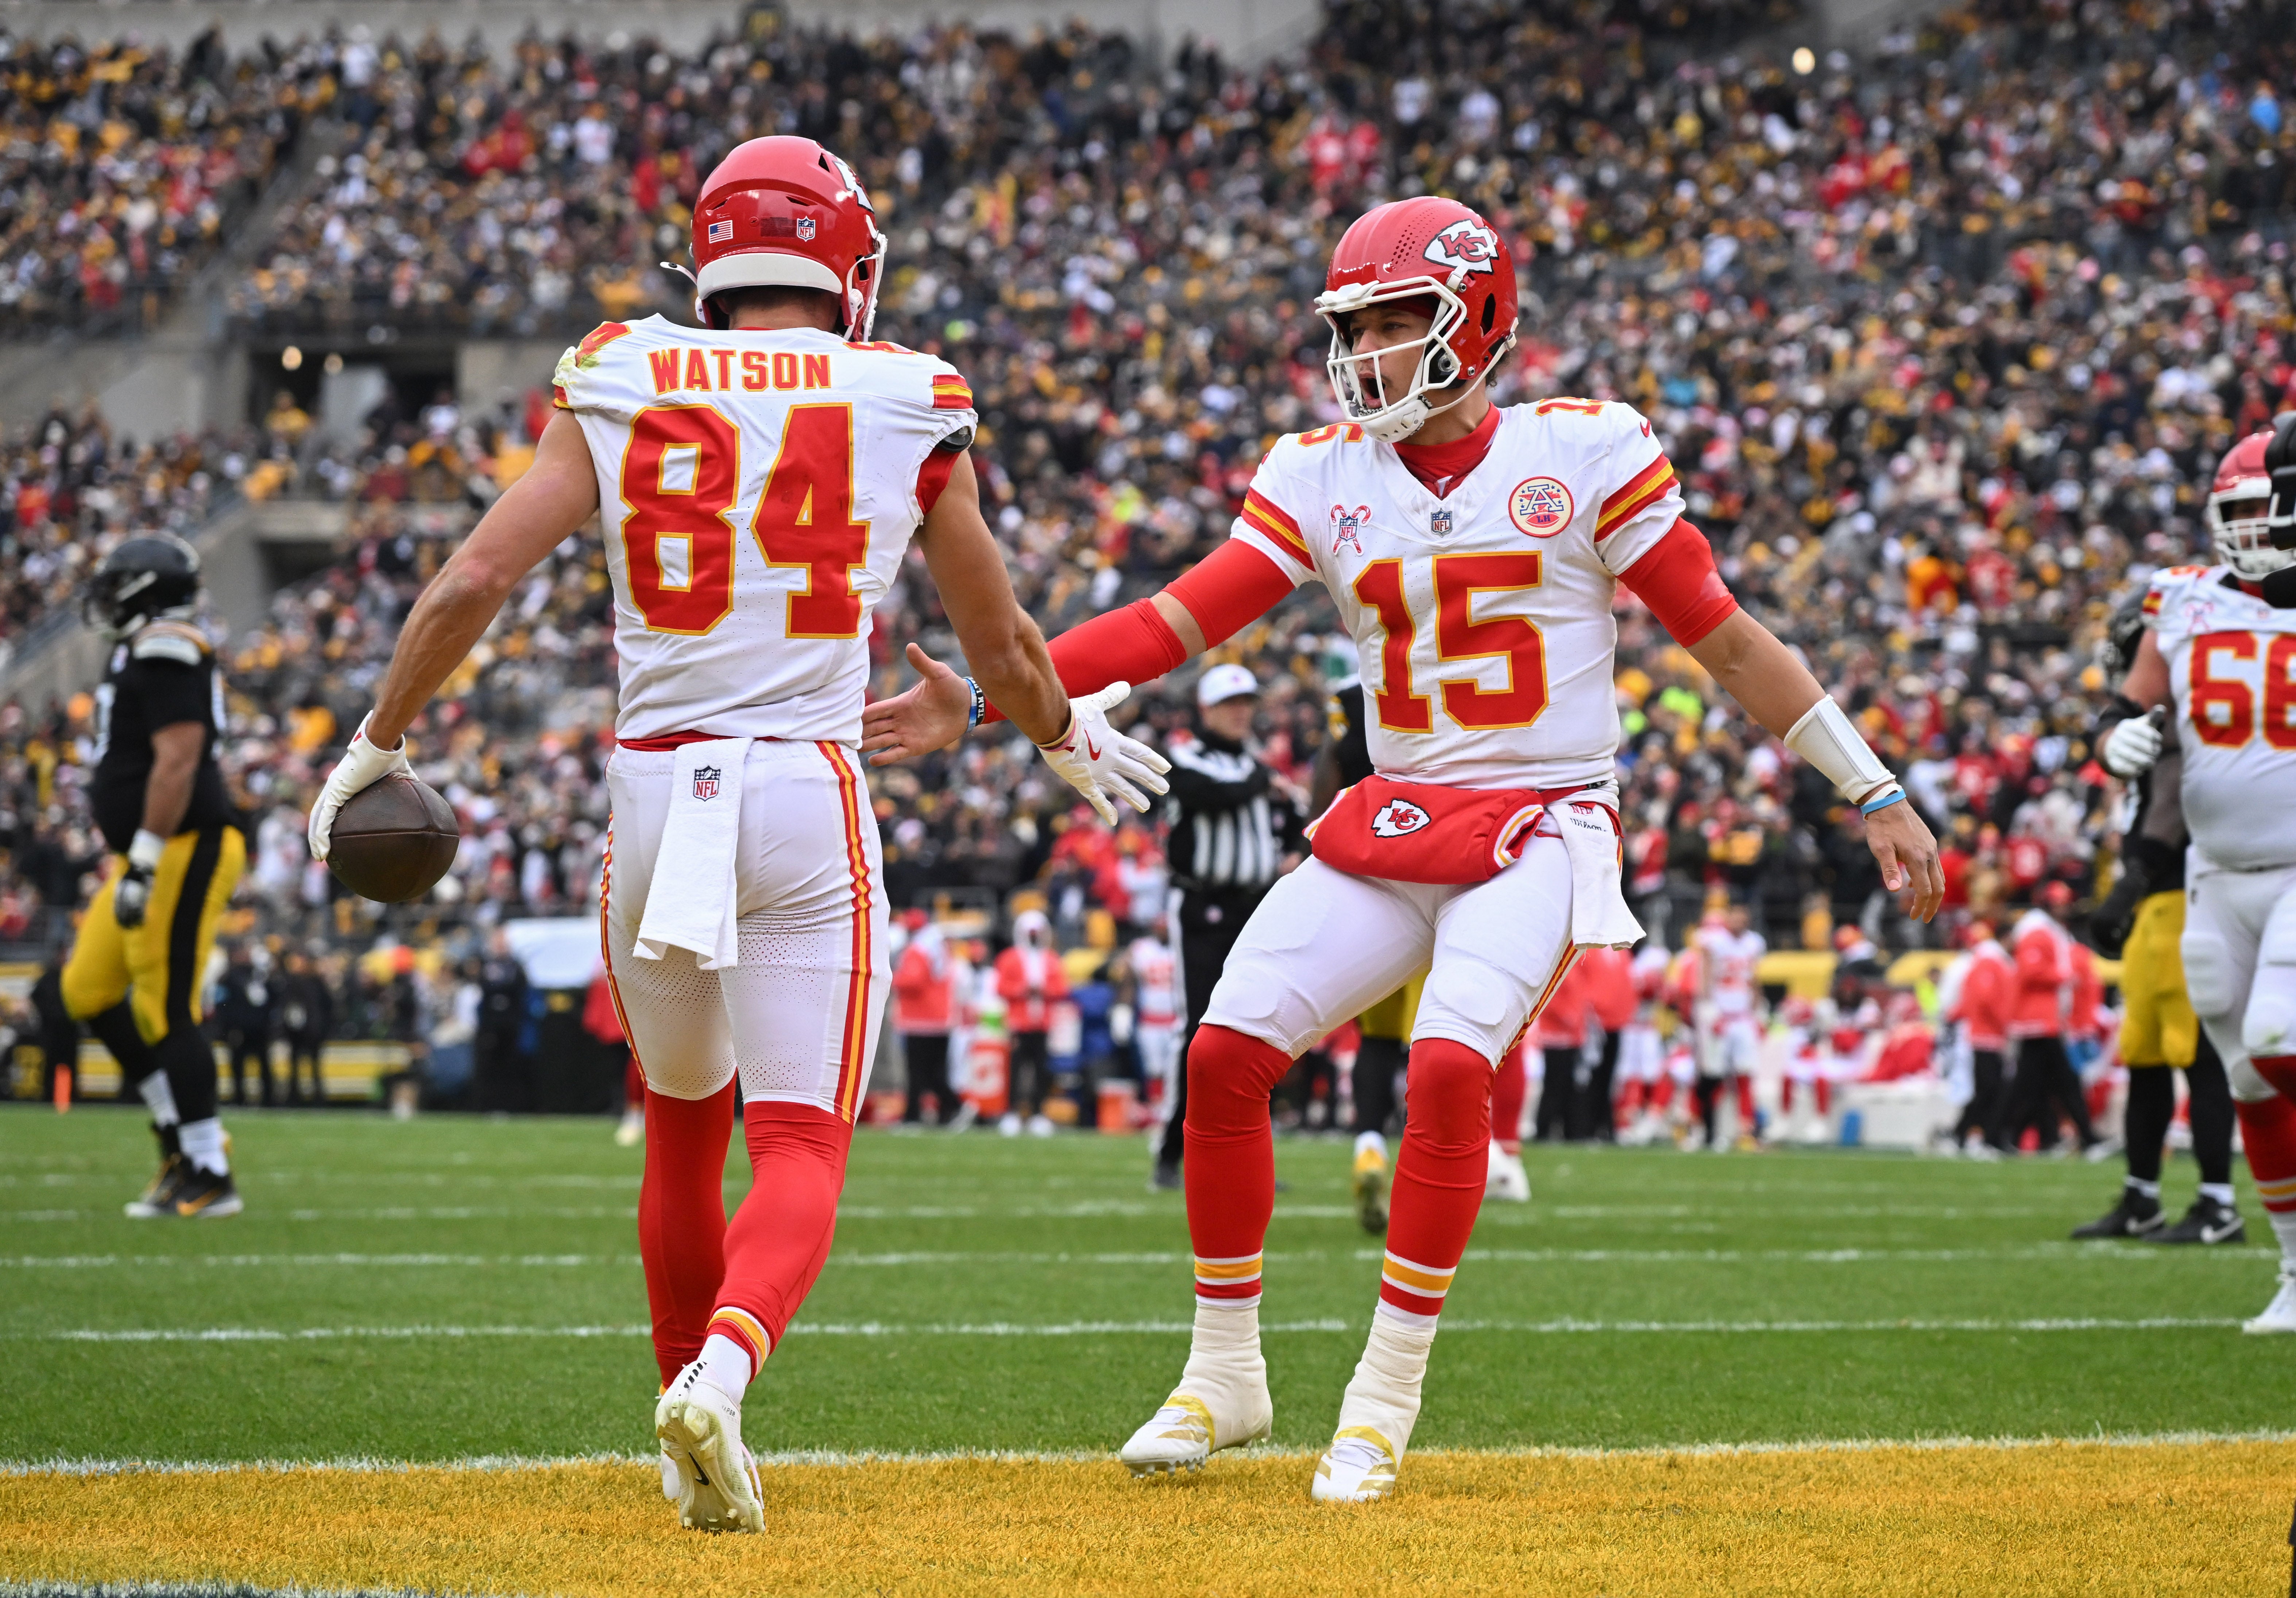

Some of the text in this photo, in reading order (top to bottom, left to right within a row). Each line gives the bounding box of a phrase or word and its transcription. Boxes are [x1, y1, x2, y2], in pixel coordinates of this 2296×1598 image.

[800, 227, 812, 237] NFL
[1438, 231, 1490, 262] KC
[647, 348, 832, 395] WATSON
[1520, 484, 1564, 516] A
[619, 402, 871, 639] 84
[1434, 521, 1449, 532] NFL
[1537, 515, 1551, 523] LH
[1340, 526, 1355, 538] NFL
[1352, 550, 1549, 734] 15
[696, 781, 717, 798] NFL
[1570, 805, 1591, 815] NFL
[1387, 808, 1420, 830] KC
[721, 1404, 736, 1417] VAPOR
